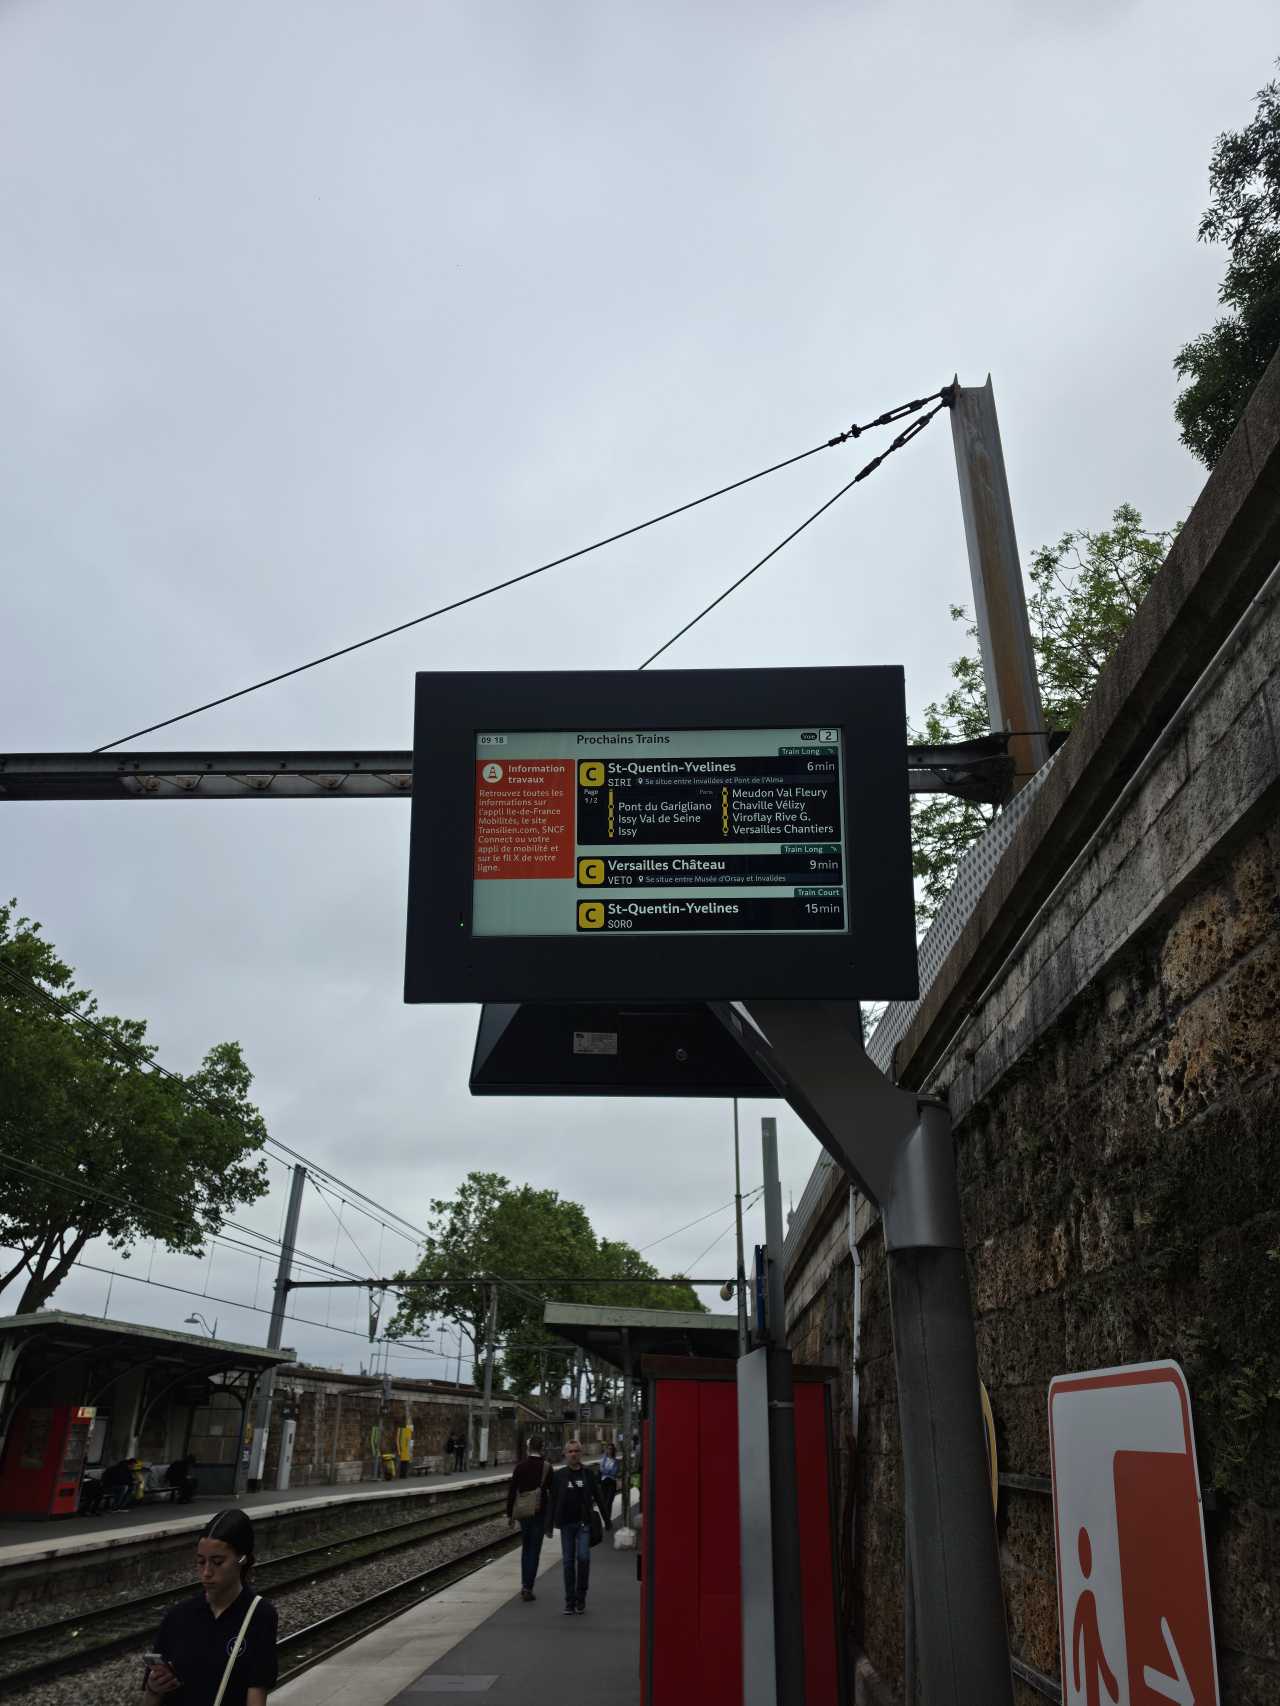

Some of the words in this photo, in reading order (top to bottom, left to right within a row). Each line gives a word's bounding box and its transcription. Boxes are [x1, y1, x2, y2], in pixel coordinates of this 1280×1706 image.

[481, 736, 492, 744] 09
[494, 736, 504, 744] 18
[576, 734, 634, 745] Prochains
[636, 734, 670, 744] Trains
[824, 731, 832, 740] 2
[801, 748, 820, 756] Long
[508, 764, 566, 774] Information
[608, 762, 736, 774] St-Quentin-Yvelines
[586, 767, 598, 782] C
[508, 776, 545, 784] travaux
[608, 778, 632, 787] SIRI
[479, 789, 521, 797] Retrouvez
[523, 789, 550, 797] toutes
[551, 789, 564, 797] les
[732, 788, 774, 798] Meudon
[776, 788, 792, 798] Val
[795, 787, 828, 799] Fleury
[479, 798, 533, 806] informations
[618, 802, 642, 812] Pont
[645, 802, 658, 811] du
[660, 801, 712, 813] Garigliano
[732, 800, 773, 810] Chaville
[775, 800, 805, 812] Vélizy
[478, 817, 520, 825] Mobilités,
[618, 814, 637, 825] Issy
[639, 814, 655, 823] Val
[658, 814, 671, 823] de
[673, 813, 701, 823] Seine
[732, 812, 772, 824] Viroflay
[775, 812, 798, 822] Rive
[800, 812, 811, 822] G.
[478, 826, 540, 835] Transilien.com,
[542, 825, 566, 834] SNCF
[618, 826, 637, 838] Issy
[732, 824, 782, 834] Versailles
[784, 824, 834, 834] Chantiers
[478, 835, 513, 844] Connect
[513, 844, 550, 852] mobilité
[804, 846, 823, 854] Long
[492, 854, 501, 862] le
[502, 854, 511, 862] fil
[512, 854, 520, 862] X
[521, 854, 532, 862] de
[534, 854, 556, 862] votre
[477, 863, 501, 873] ligne.
[608, 859, 669, 871] Versailles
[672, 858, 726, 870] Château
[586, 864, 597, 879] C
[718, 874, 745, 883] d'Orsay
[755, 874, 786, 882] Invalides
[817, 888, 840, 896] Court
[608, 902, 740, 916] St-Quentin-Yvelines
[585, 908, 597, 923] C
